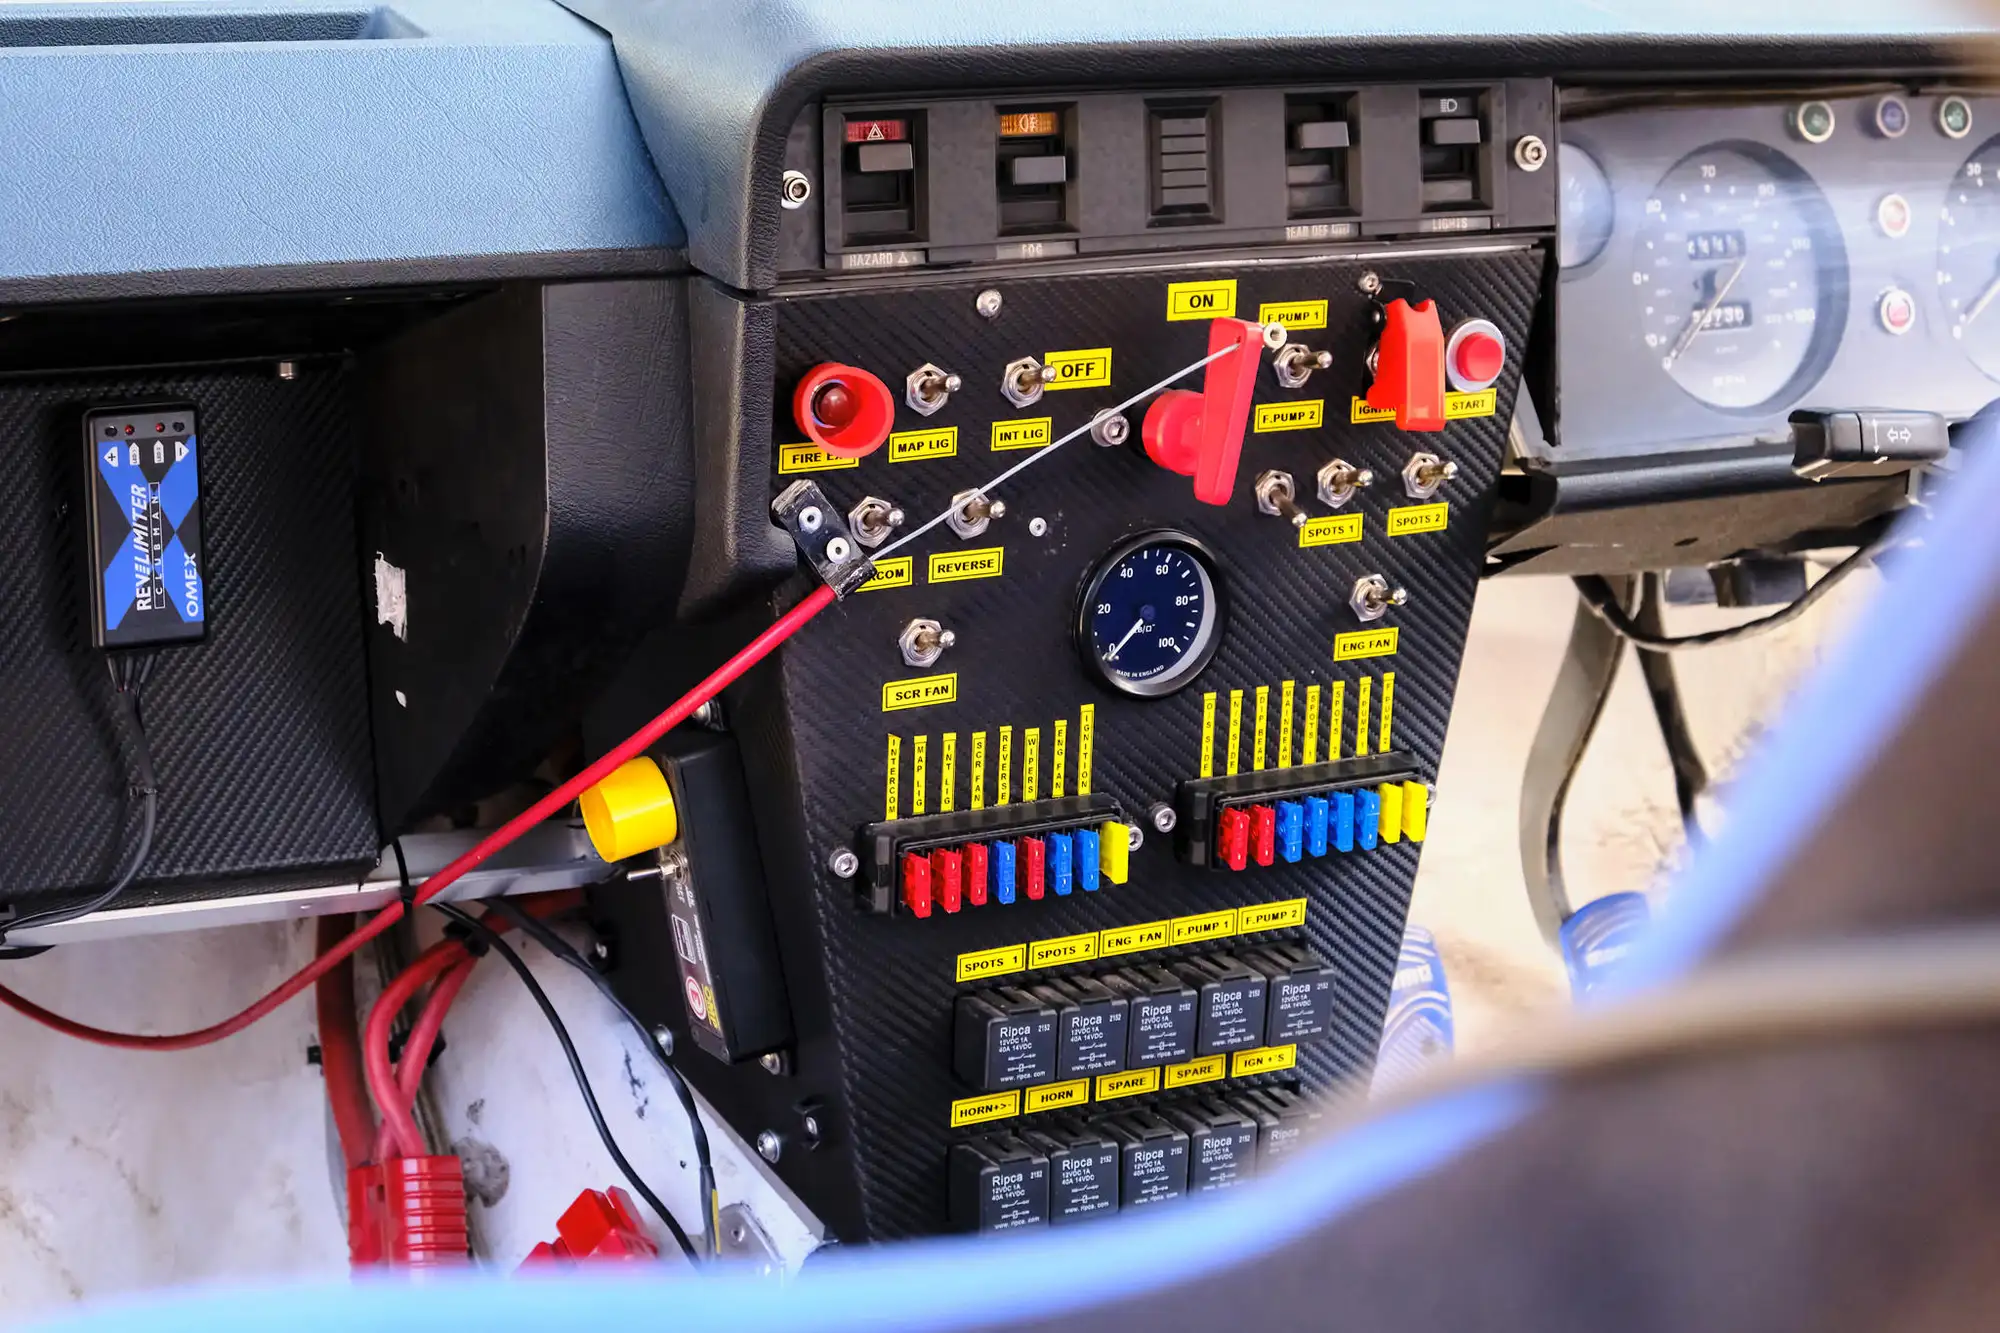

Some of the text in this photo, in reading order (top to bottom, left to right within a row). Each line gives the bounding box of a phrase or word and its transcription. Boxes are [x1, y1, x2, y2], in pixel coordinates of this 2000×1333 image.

[1432, 217, 1468, 230] LIGHTS
[1021, 243, 1043, 257] FOG
[849, 252, 893, 266] HAZARD
[1189, 294, 1214, 309] ON
[1267, 310, 1320, 324] F.PUMP 1
[1060, 362, 1096, 378] OFF
[1452, 399, 1485, 411] START
[1262, 410, 1316, 424] F.PUMP 2
[999, 428, 1043, 442] INT LIG
[898, 438, 950, 453] MAP LIG
[792, 452, 822, 464] FIRE
[1396, 514, 1441, 527] SPOTS 2
[1308, 524, 1354, 538] SPOTS 1
[152, 495, 163, 595] CLUBMAN
[937, 558, 995, 574] REVERSE
[1120, 567, 1134, 578] 40
[1156, 564, 1169, 576] 60
[184, 552, 199, 617] OMEX
[1175, 595, 1188, 606] 80
[1098, 603, 1111, 614] 20
[1158, 637, 1174, 648] 100
[1342, 638, 1390, 652] ENG FAN
[1116, 668, 1130, 678] MADE
[1138, 664, 1164, 678] ENGLAND
[896, 685, 949, 702] SCR FAN
[1308, 696, 1316, 738] SPOTS
[1081, 714, 1090, 788] IGNITION
[1230, 734, 1238, 768] SIDE
[1256, 728, 1264, 764] BEAM
[916, 746, 924, 772] MAP
[1028, 738, 1036, 794] WIPERS
[1000, 734, 1008, 800] REVERSE
[888, 739, 897, 813] INTERCOM
[1246, 910, 1298, 926] F.PUMP 2
[1178, 920, 1228, 937] F.PUMP 1
[1108, 931, 1162, 948] ENG FAN
[1037, 944, 1091, 960] SPOTS 2
[964, 955, 1018, 972] SPOTS 1
[1282, 984, 1310, 996] Ripca
[1212, 992, 1242, 1004] Ripca
[1142, 1004, 1172, 1018] Ripca
[1072, 1016, 1102, 1030] Ripca
[1000, 1026, 1030, 1040] Ripca
[1071, 1027, 1090, 1036] 12VDC
[1084, 1032, 1104, 1040] 14VDC
[1000, 1037, 1018, 1046] 12VDC
[1244, 1058, 1264, 1068] IGN
[1177, 1065, 1214, 1079] SPARE
[1108, 1077, 1147, 1092] SPARE
[1041, 1090, 1073, 1102] HORN
[1271, 1128, 1300, 1141] Ripca
[1203, 1136, 1232, 1150] Ripca
[1134, 1148, 1164, 1162] Ripca
[1062, 1158, 1092, 1172] Ripca
[992, 1174, 1023, 1188] Ripca
[1062, 1170, 1082, 1178] 12VDC
[1076, 1174, 1094, 1182] 14VDC
[992, 1185, 1012, 1194] 12VDC
[1006, 1190, 1025, 1198] 14VDC
